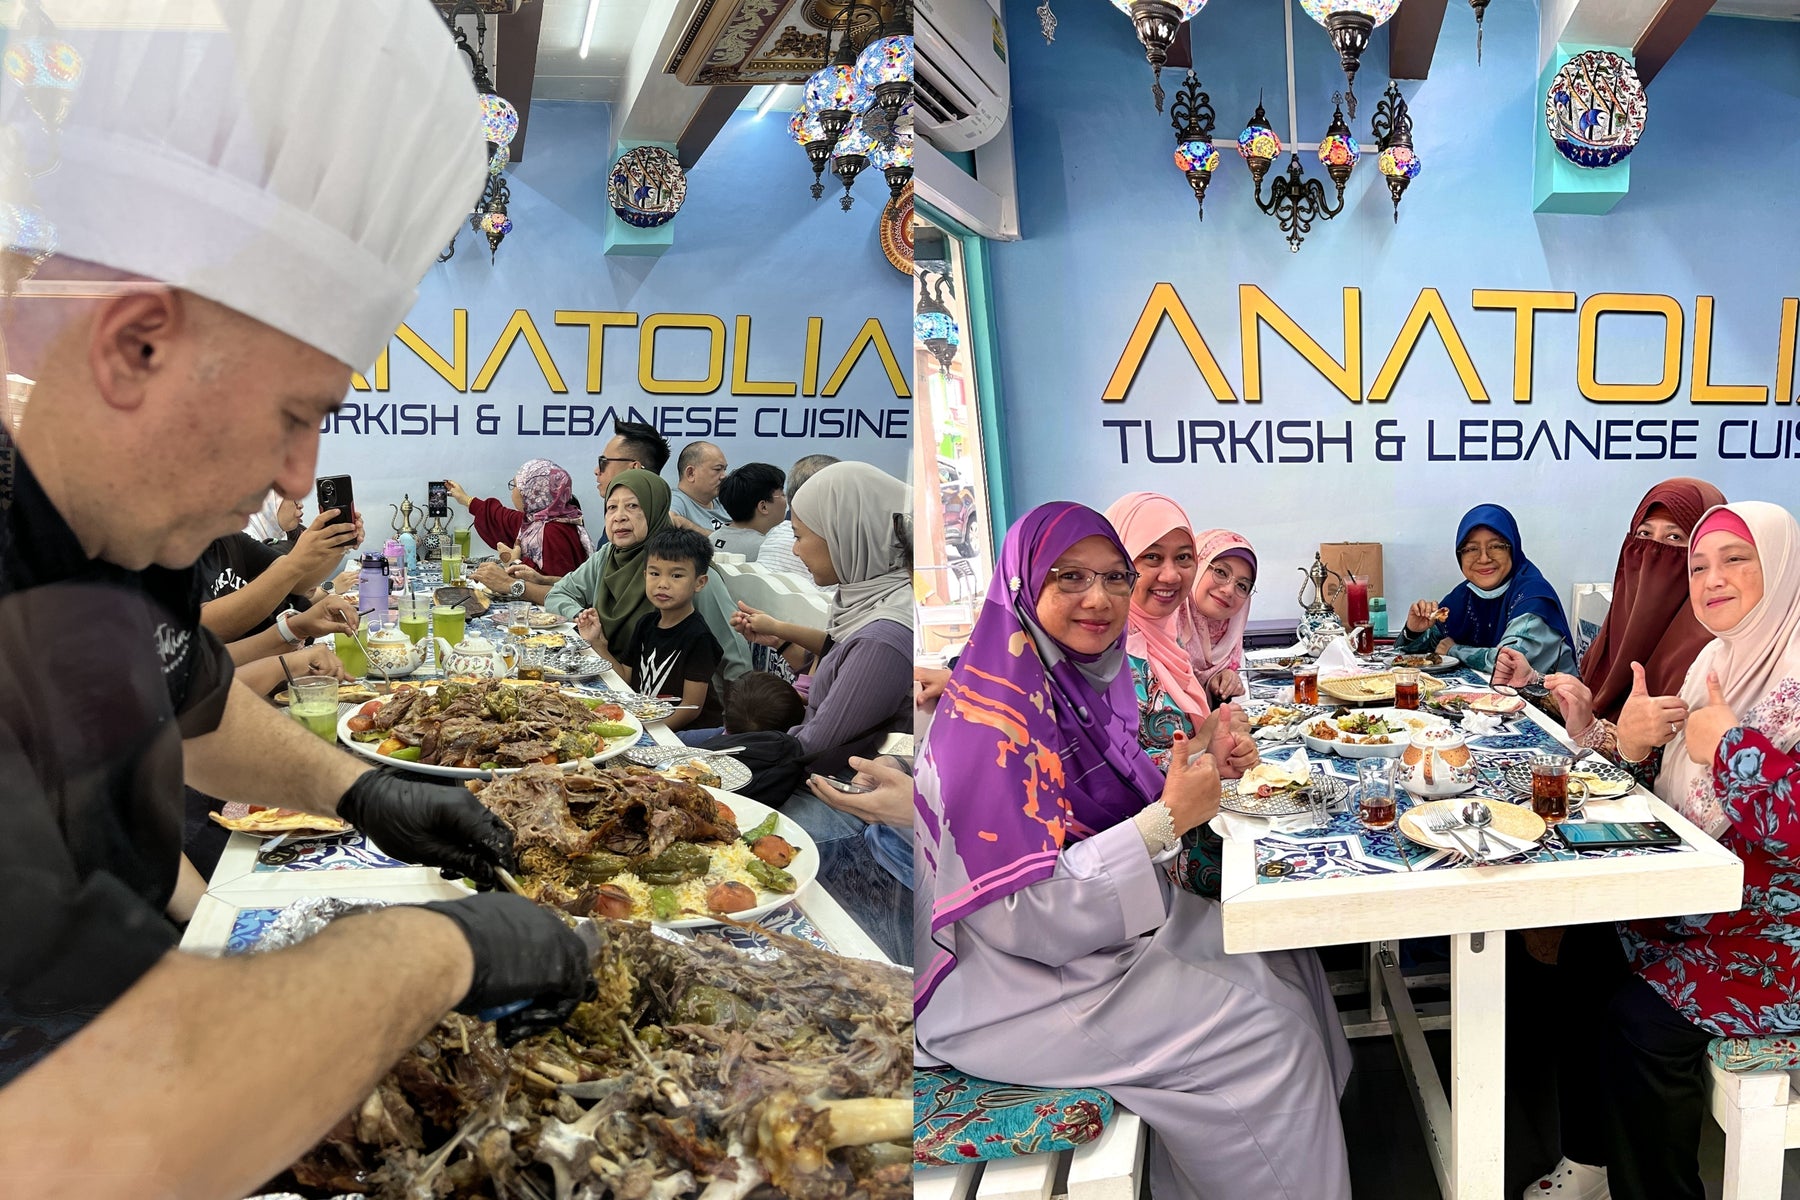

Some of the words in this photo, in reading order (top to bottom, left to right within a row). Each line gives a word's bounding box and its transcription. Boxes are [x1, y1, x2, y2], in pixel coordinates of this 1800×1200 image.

[350, 308, 911, 397] NATOLIA
[1101, 282, 1800, 404] ANATOLI
[319, 403, 459, 436] RKISH
[477, 404, 500, 435] &
[517, 404, 738, 437] LEBANESE
[754, 407, 909, 439] CUISINE
[1102, 419, 1352, 464] TURKISH
[1375, 419, 1406, 462] &
[1427, 419, 1699, 461] LEBANESE
[1718, 419, 1800, 460] CUI
